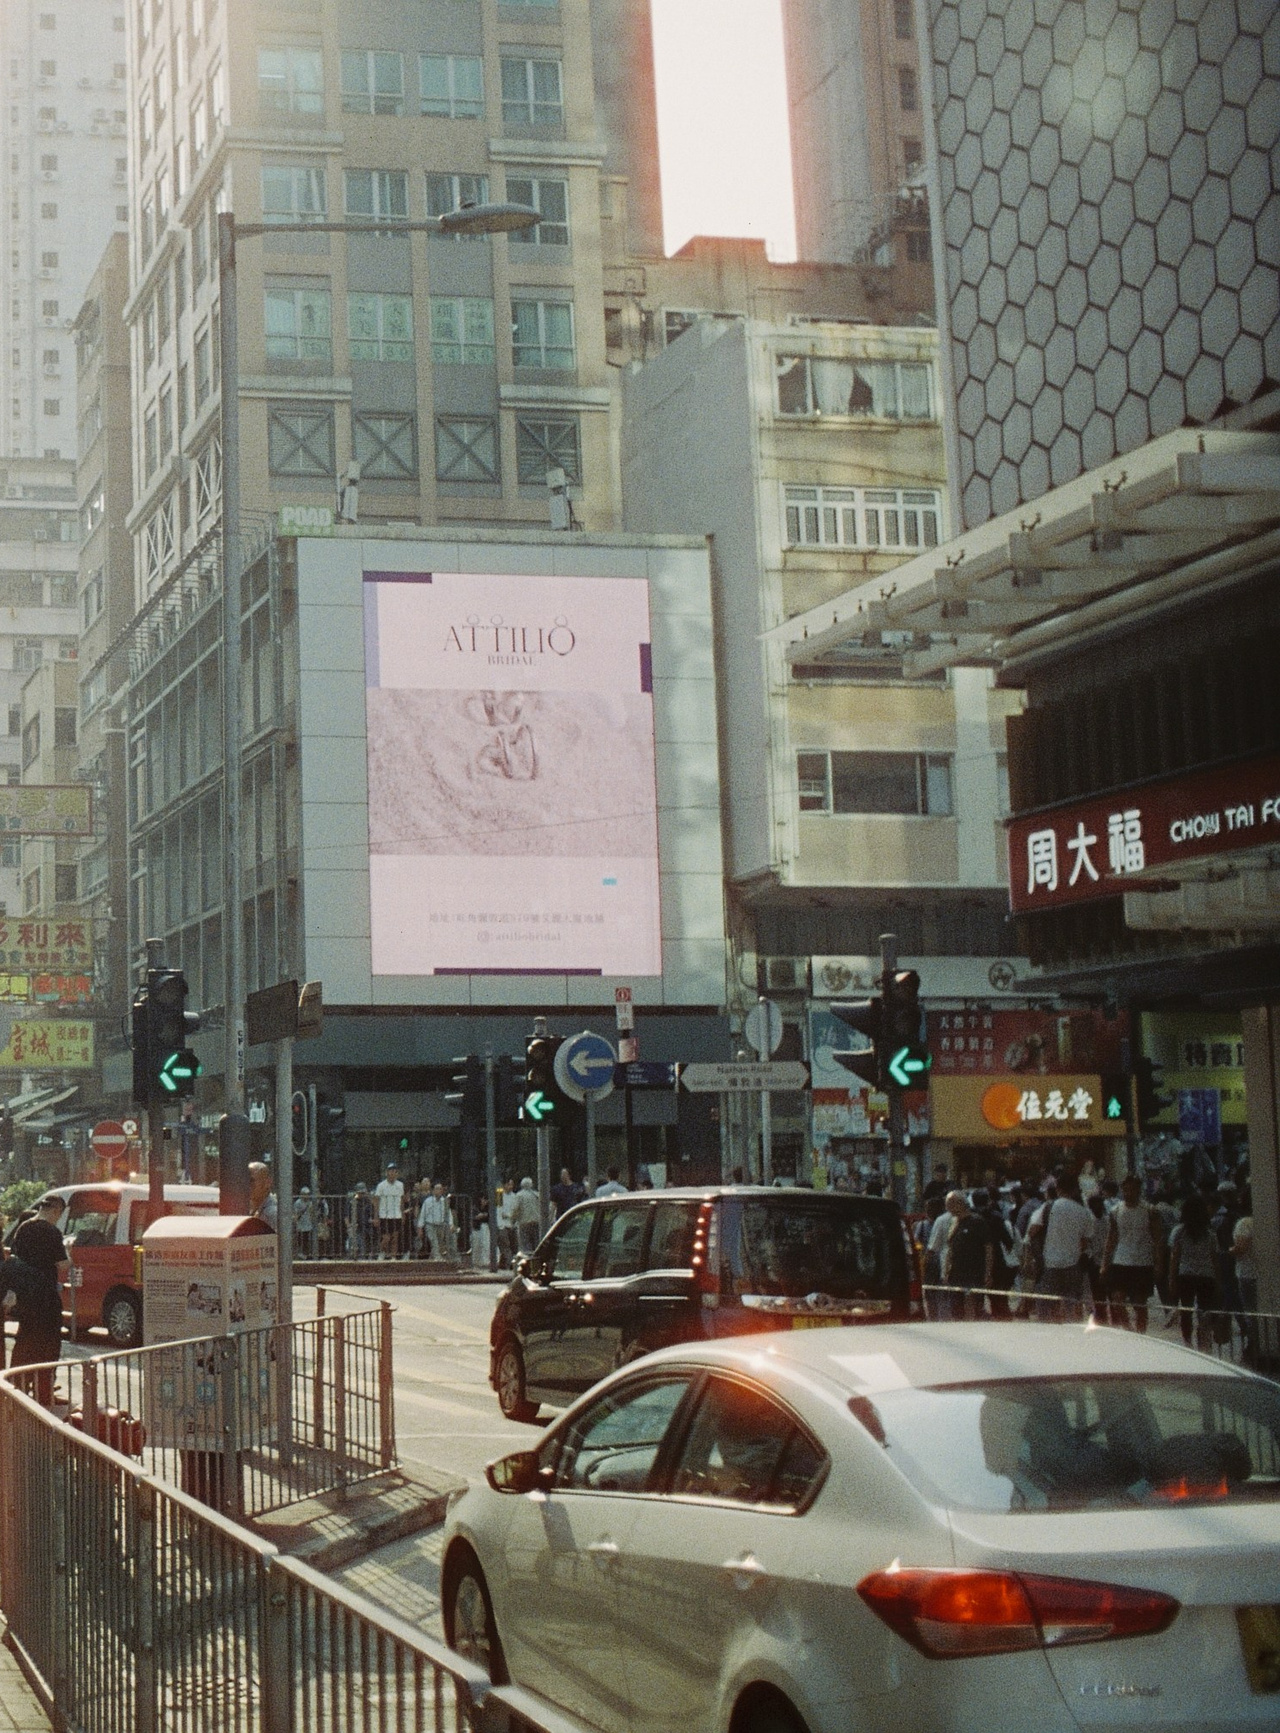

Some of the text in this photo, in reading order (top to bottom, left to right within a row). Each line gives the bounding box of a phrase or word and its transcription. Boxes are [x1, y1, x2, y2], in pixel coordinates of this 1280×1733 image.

[443, 613, 577, 657] ATTILIO
[487, 654, 536, 667] BRIDAL
[1170, 812, 1220, 843] CHOW
[1224, 804, 1254, 830] TAI
[1027, 808, 1145, 895] 周大福
[716, 1065, 773, 1074] Nathan Road
[1016, 1087, 1093, 1121] 位元堂
